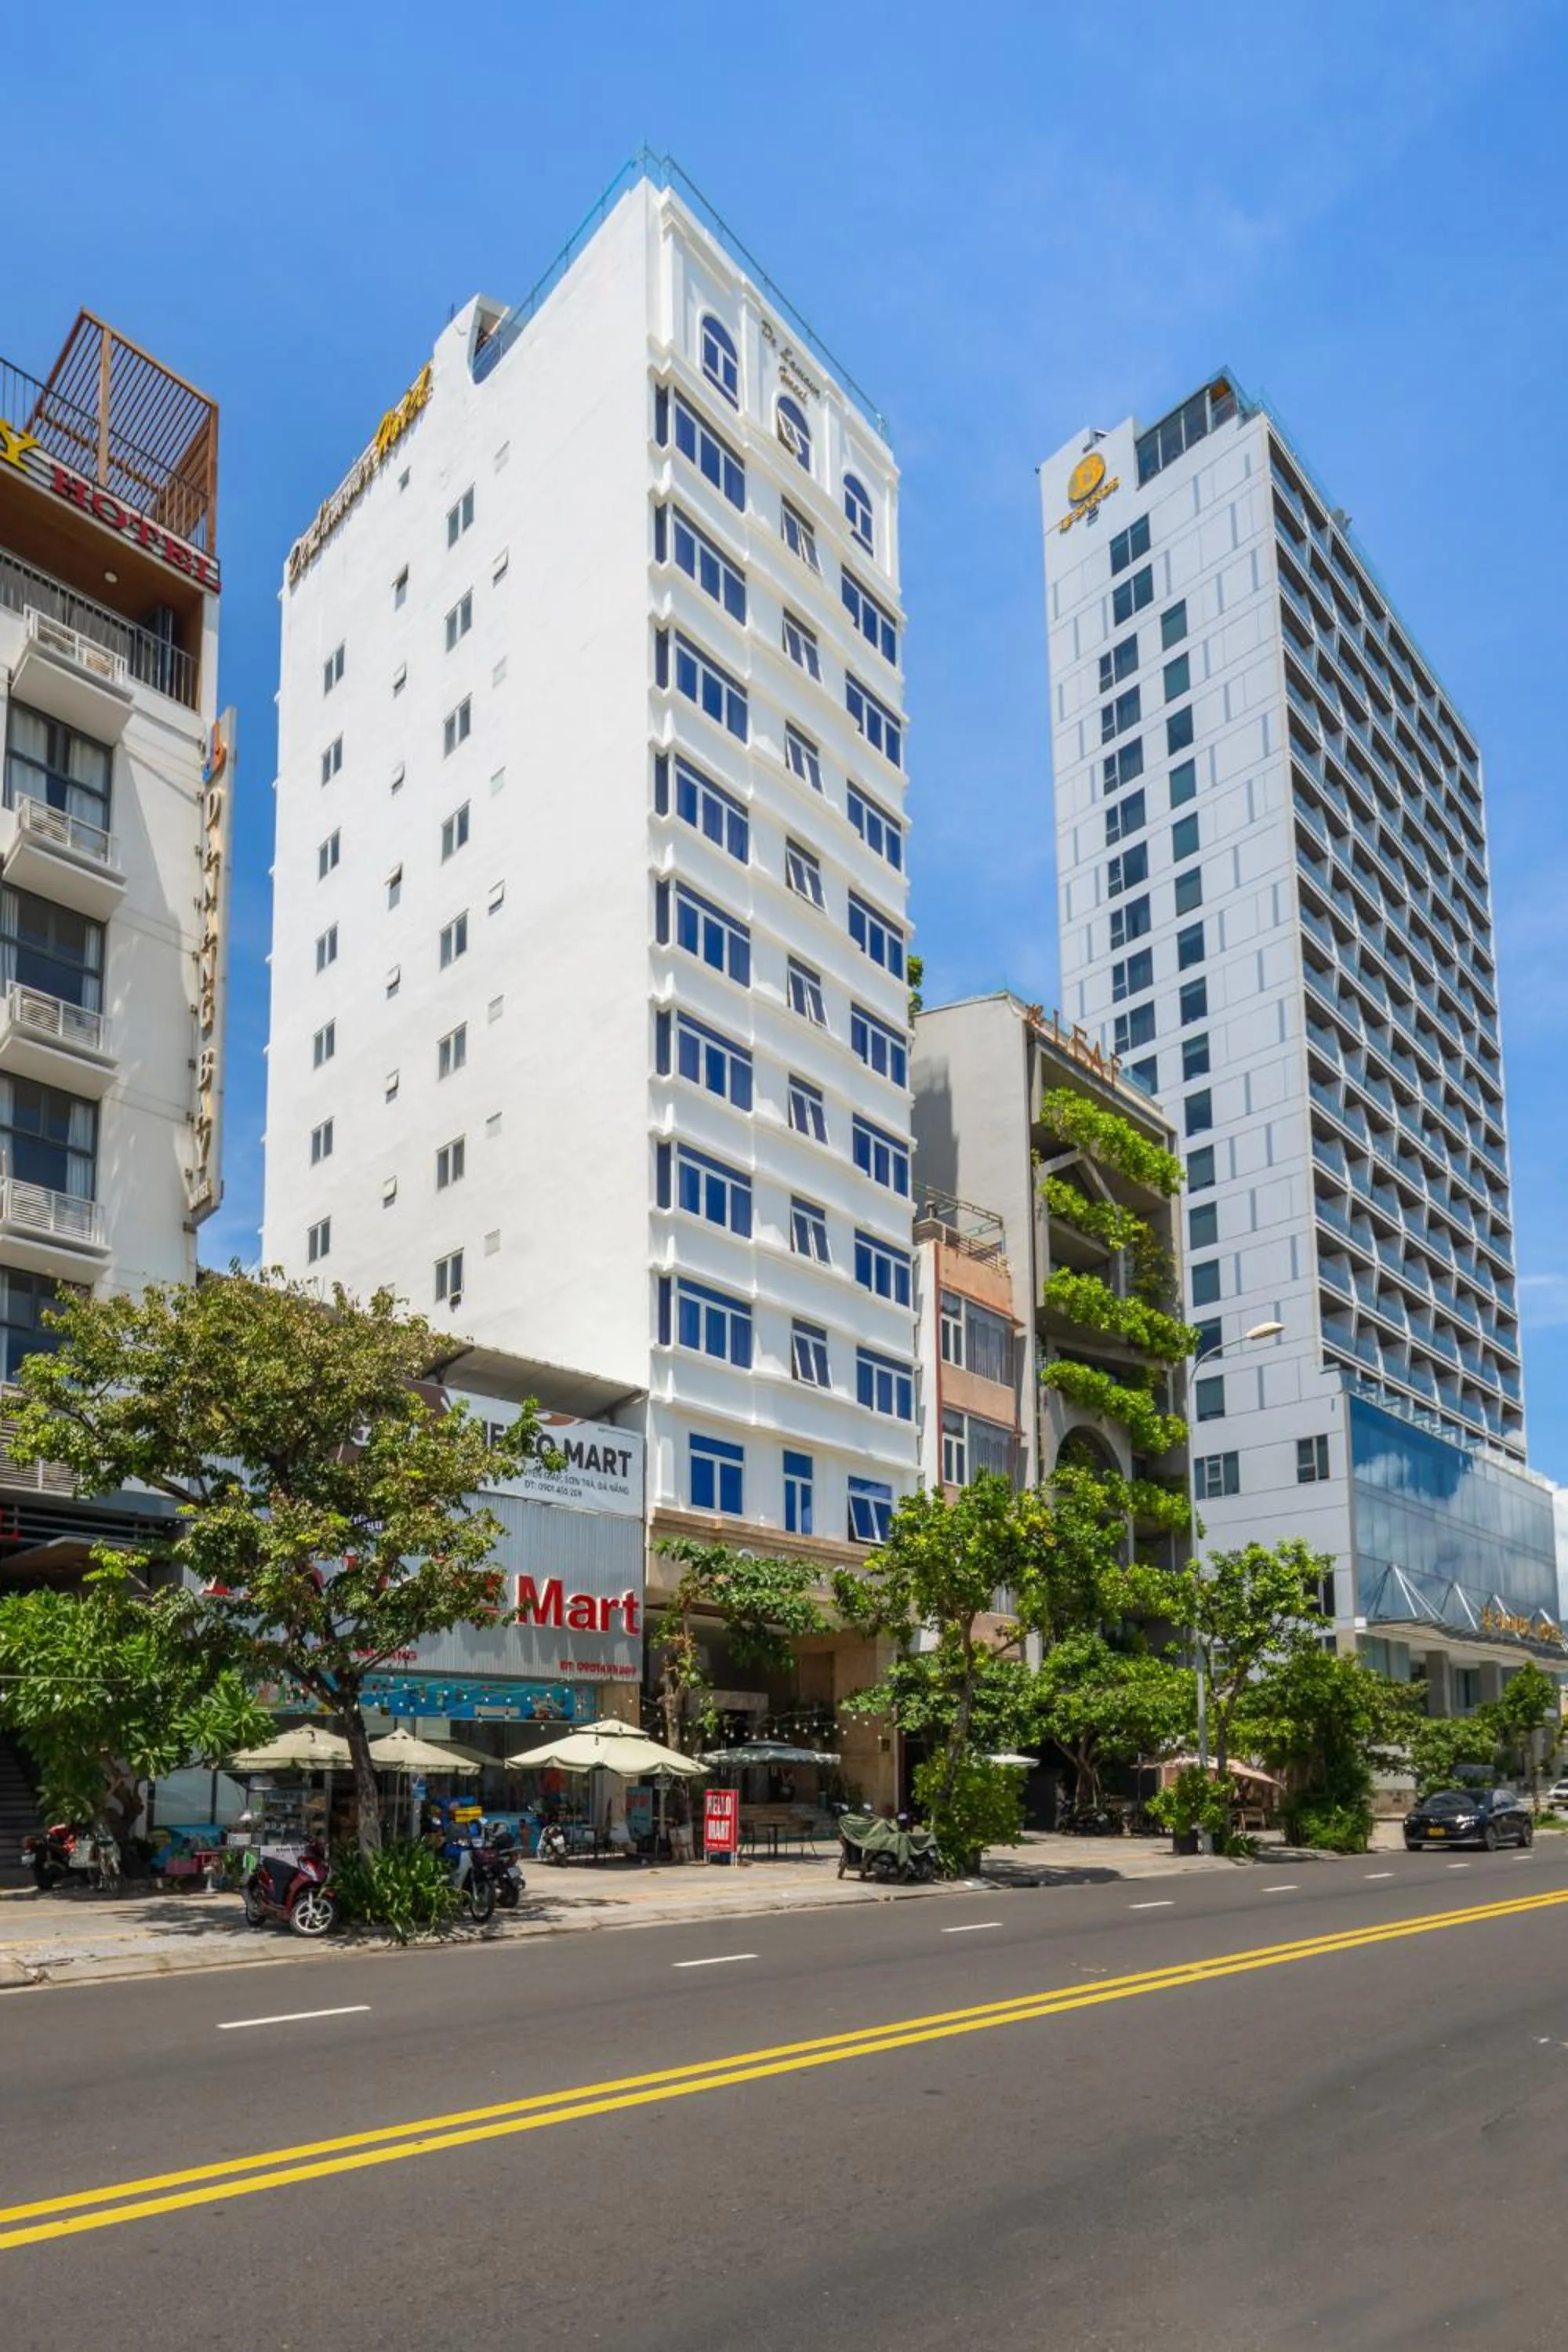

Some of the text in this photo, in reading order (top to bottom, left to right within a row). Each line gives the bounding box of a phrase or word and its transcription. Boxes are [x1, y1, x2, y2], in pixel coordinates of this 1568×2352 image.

[51, 464, 221, 593] HOTEL
[564, 1438, 632, 1477] MART
[515, 1573, 641, 1636] Mart
[706, 1795, 731, 1816] HELLO
[708, 1820, 731, 1840] MART
